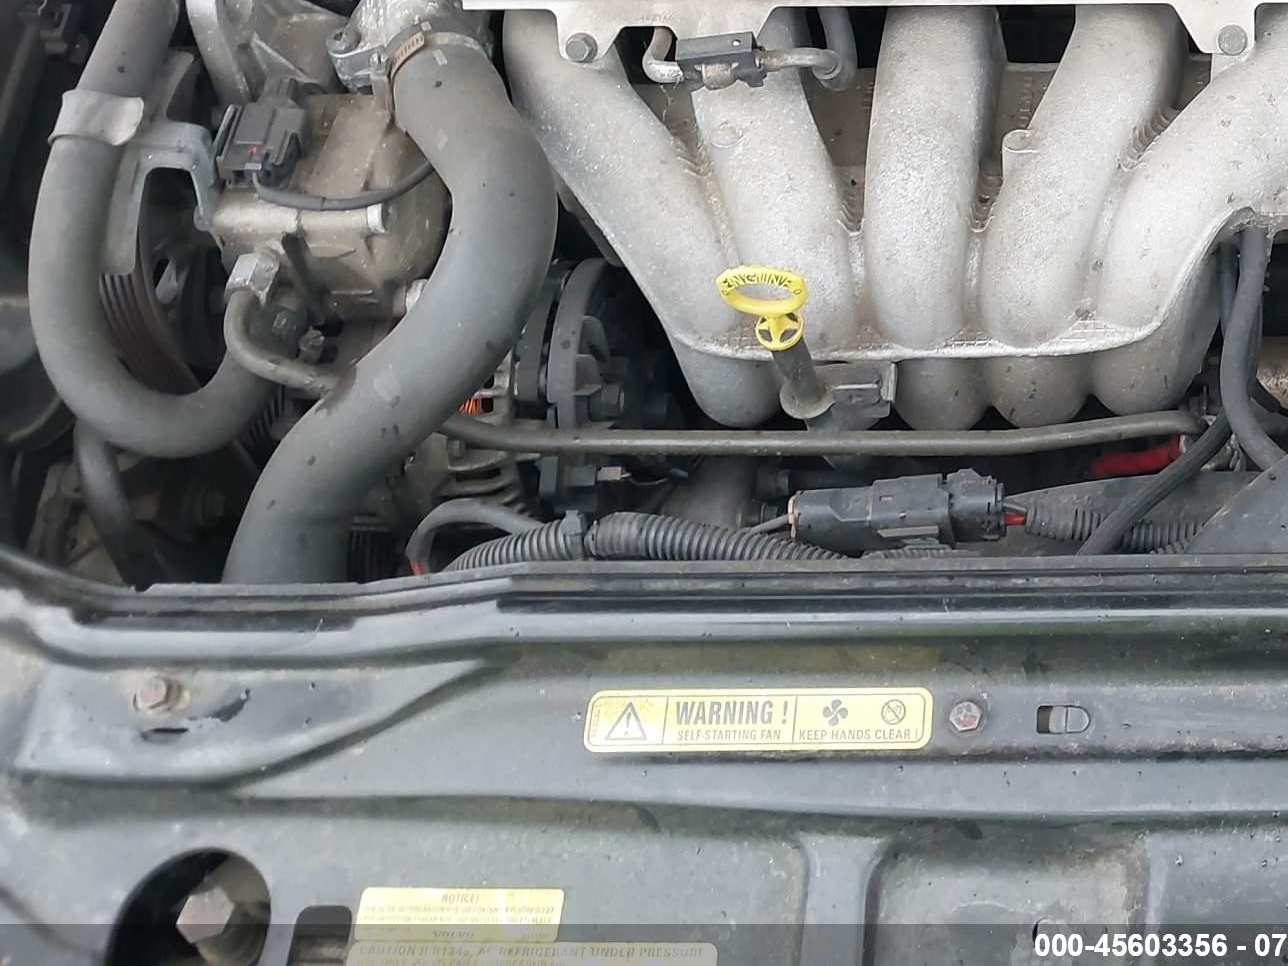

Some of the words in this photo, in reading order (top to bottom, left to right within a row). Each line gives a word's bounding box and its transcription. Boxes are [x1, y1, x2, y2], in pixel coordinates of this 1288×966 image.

[675, 701, 774, 726] WARNING
[677, 729, 757, 741] SELF-STARTING
[759, 729, 782, 740] FAN
[799, 729, 828, 741] KEEP
[831, 729, 871, 740] HANDS
[874, 729, 911, 740] CLEAR
